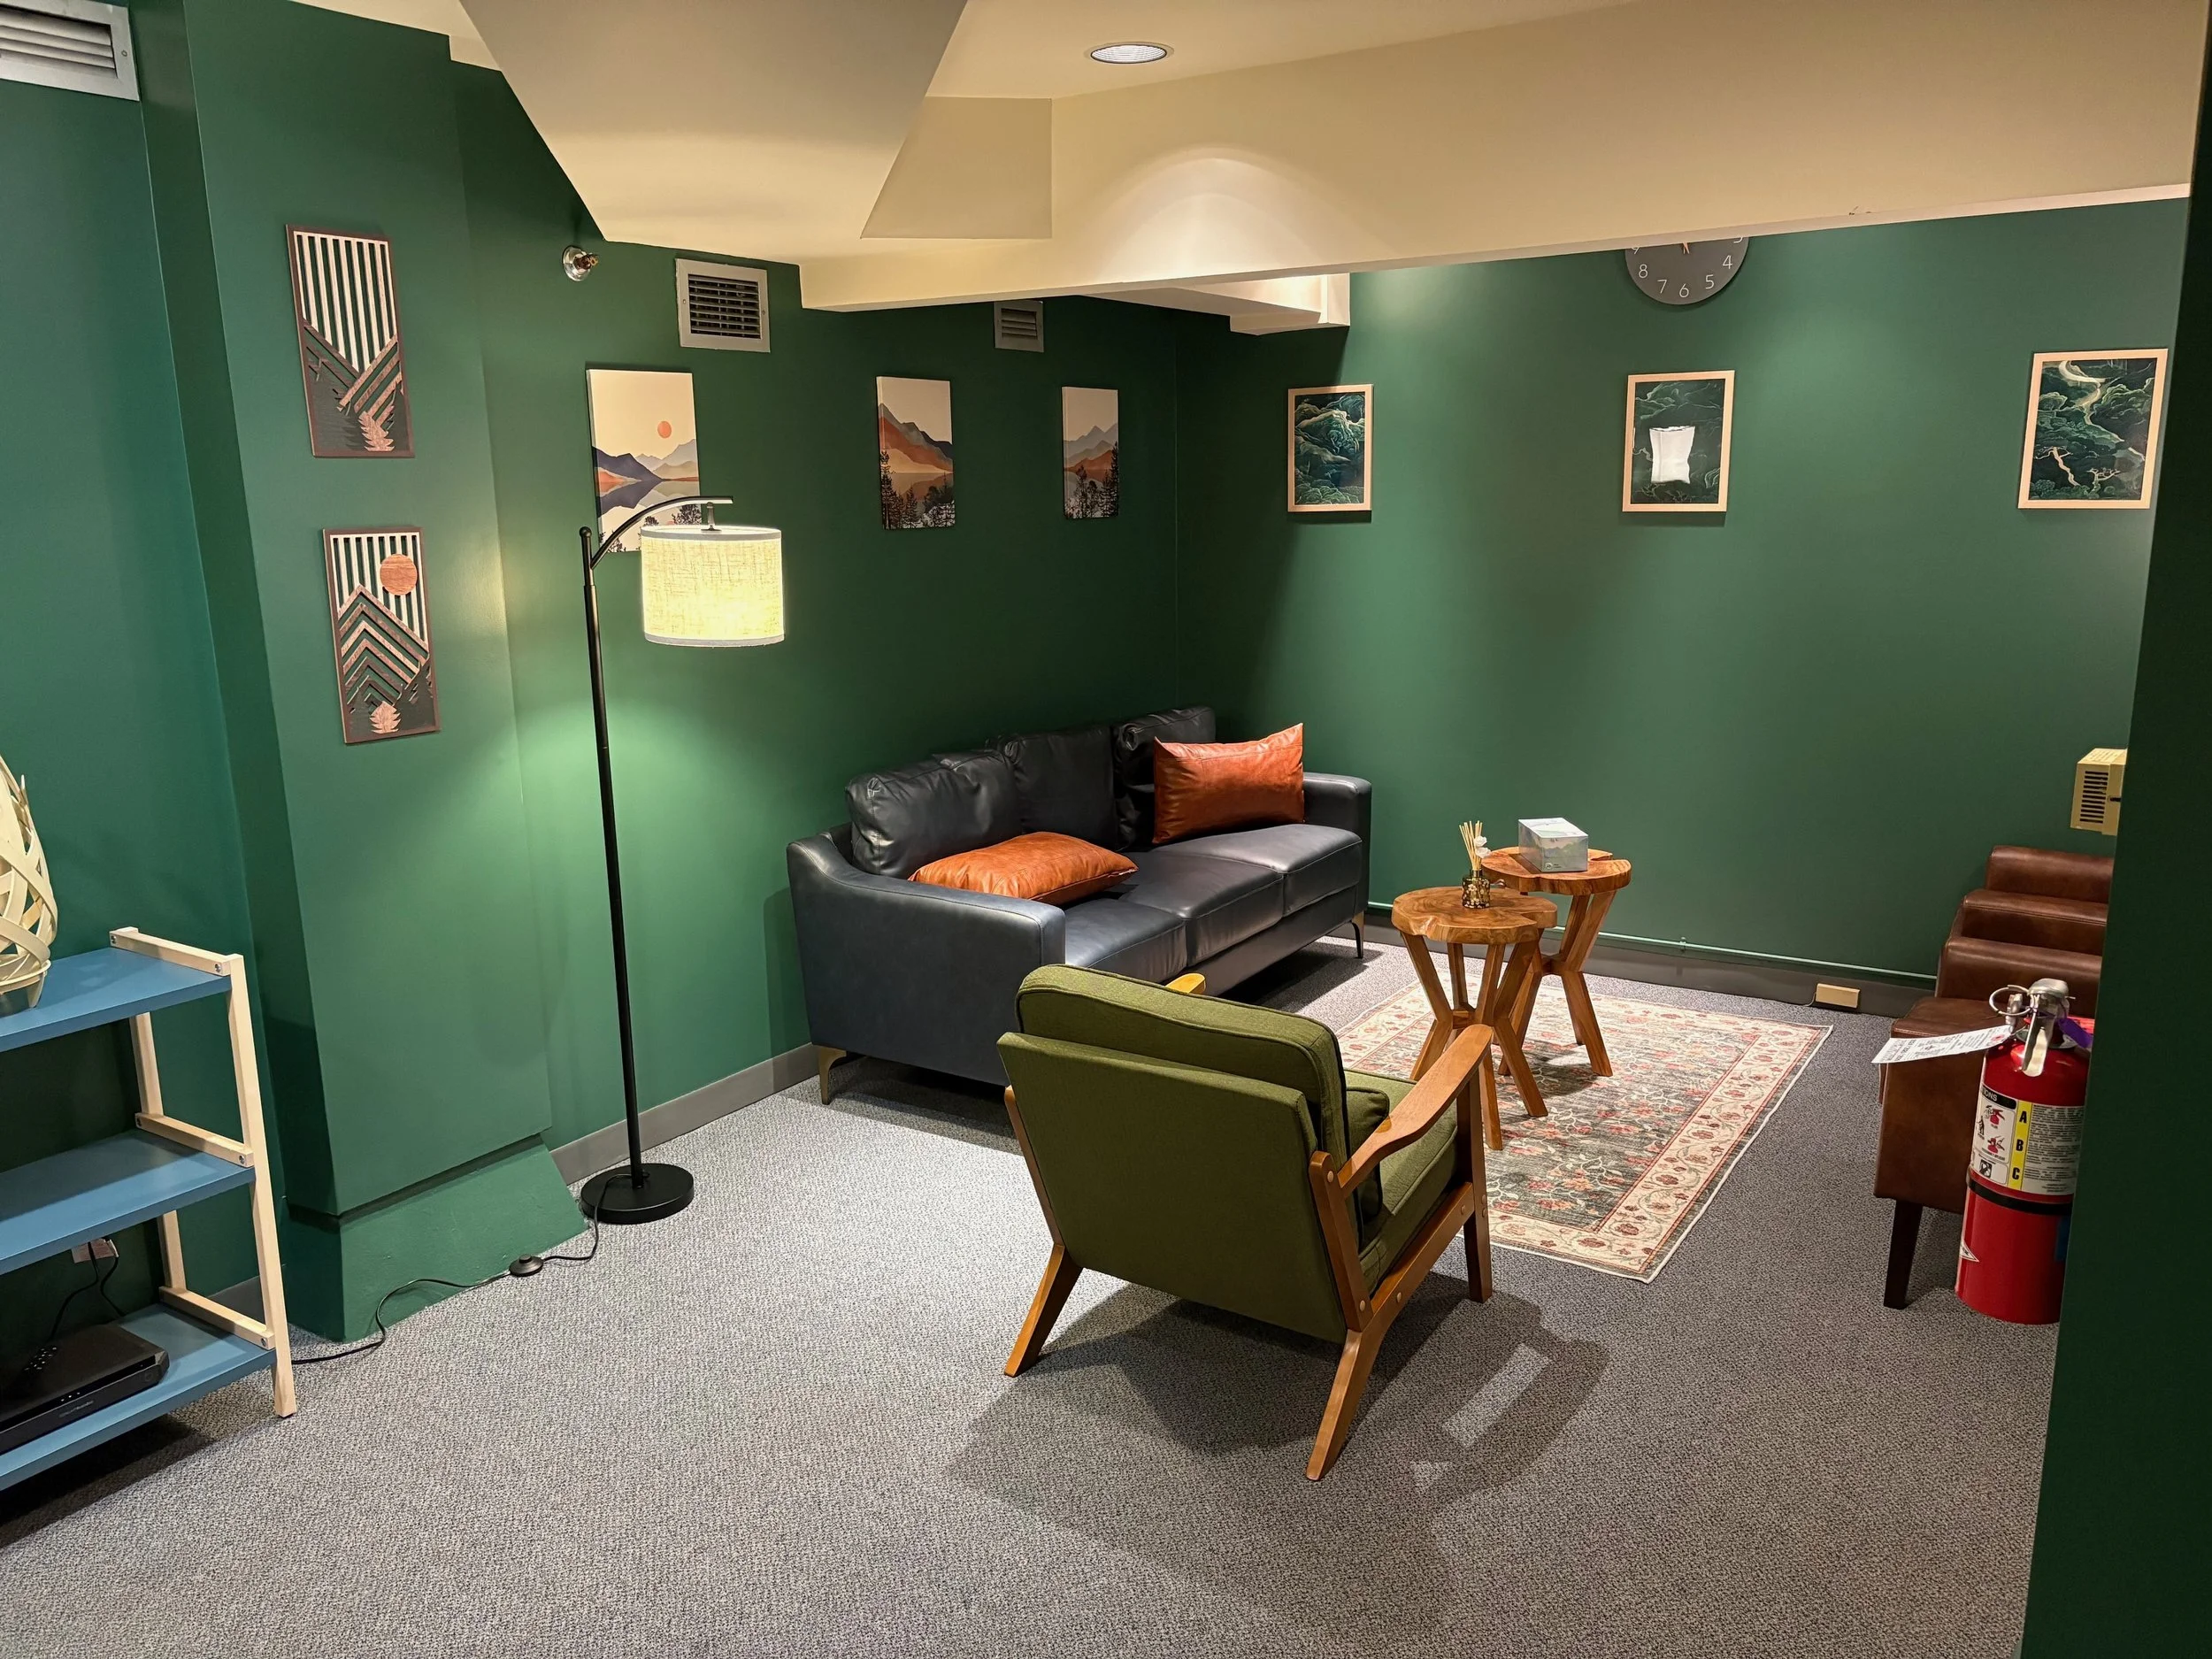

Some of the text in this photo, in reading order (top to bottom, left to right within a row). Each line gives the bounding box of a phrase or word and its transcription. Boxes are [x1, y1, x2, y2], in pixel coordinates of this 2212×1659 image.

[1723, 255, 1732, 269] 4
[1638, 264, 1648, 278] 8
[1657, 280, 1667, 294] 7
[1705, 274, 1715, 289] 5
[1678, 283, 1690, 298] 6
[2019, 1110, 2027, 1124] A
[2016, 1139, 2024, 1151] B
[2012, 1167, 2020, 1180] C
